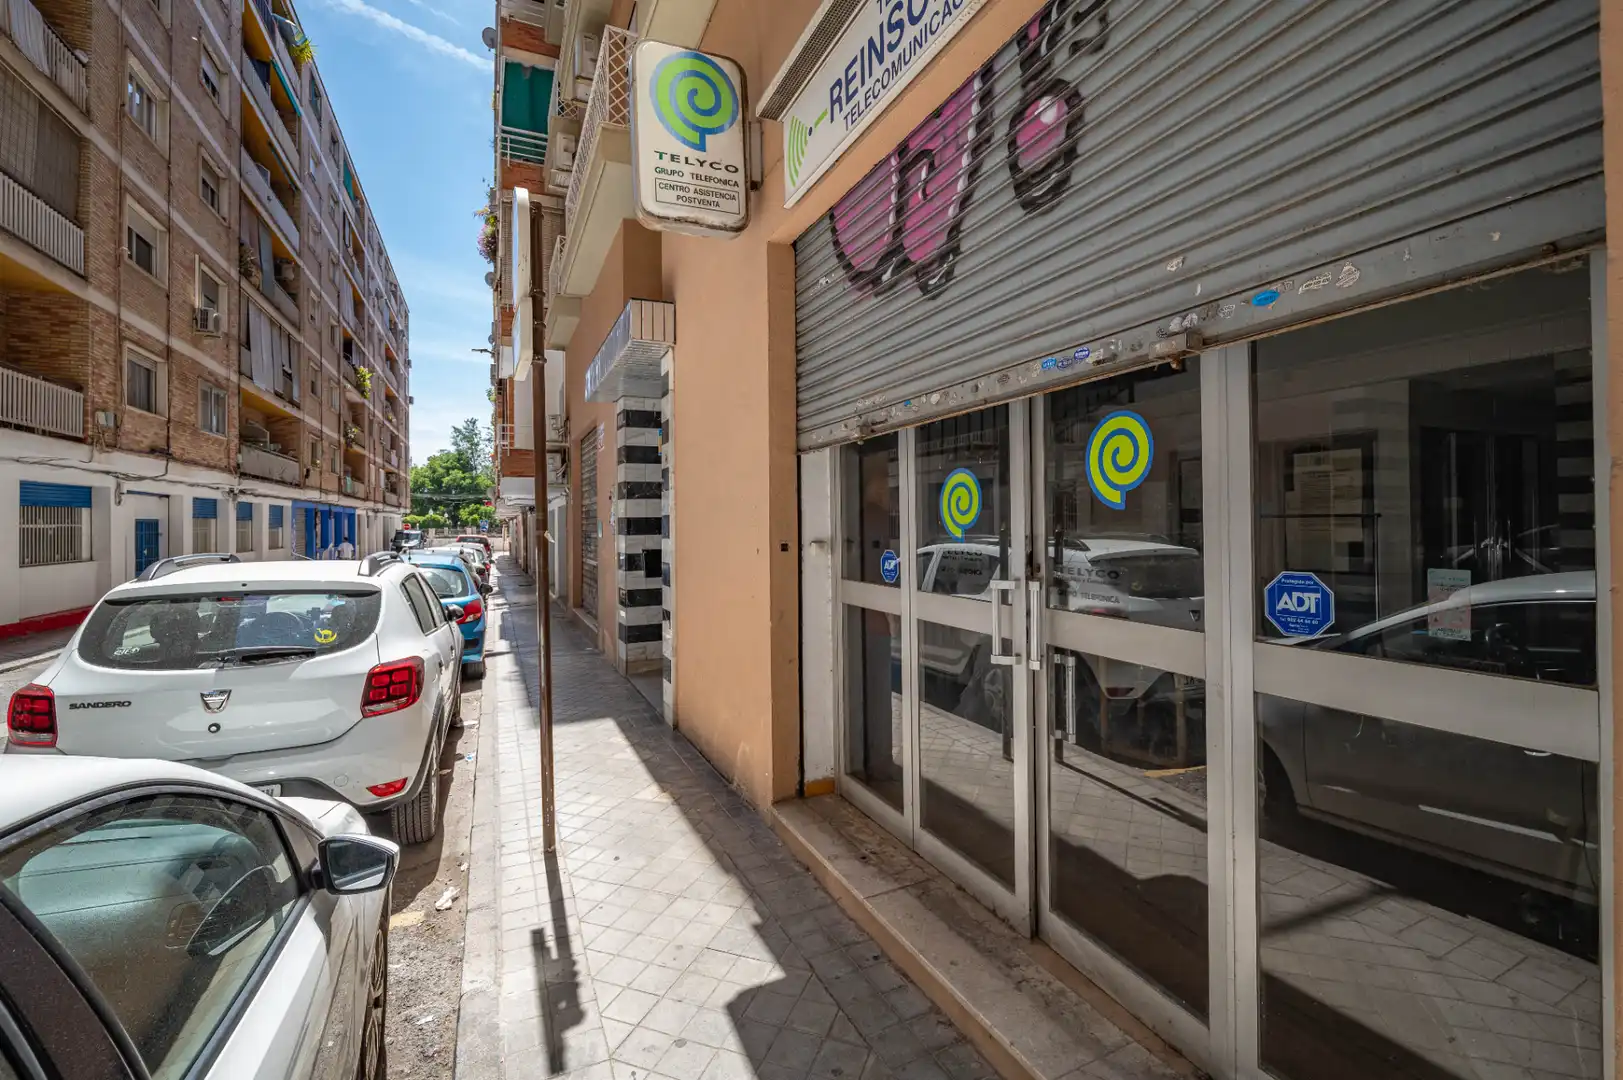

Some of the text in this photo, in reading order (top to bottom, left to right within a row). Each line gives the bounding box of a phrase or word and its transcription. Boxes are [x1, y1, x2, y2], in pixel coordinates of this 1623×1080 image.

[654, 150, 739, 174] TELYCO
[654, 166, 739, 188] GRUPO TELEFONICA
[658, 182, 737, 201] CENTRO ASISTENCIA
[676, 194, 720, 208] POSTVENTA
[1276, 591, 1321, 614] ADT
[68, 700, 132, 710] SANDERO
